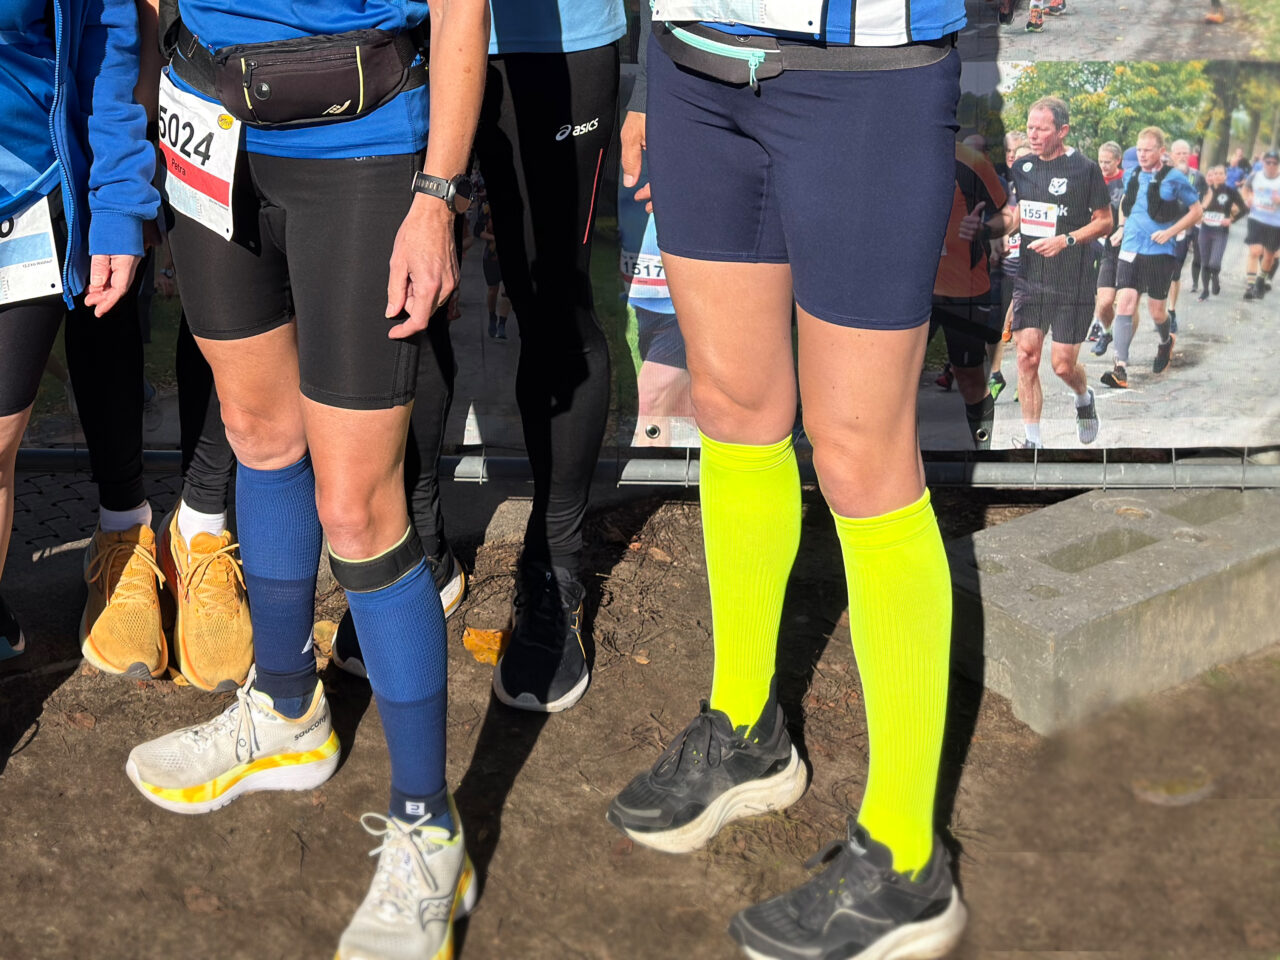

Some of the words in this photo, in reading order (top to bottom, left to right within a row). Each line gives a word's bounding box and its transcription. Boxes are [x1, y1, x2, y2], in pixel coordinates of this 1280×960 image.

[158, 104, 215, 166] 5024
[572, 117, 599, 136] asics
[171, 157, 186, 176] Petra
[1023, 208, 1049, 220] 1551
[624, 261, 663, 277] 1517
